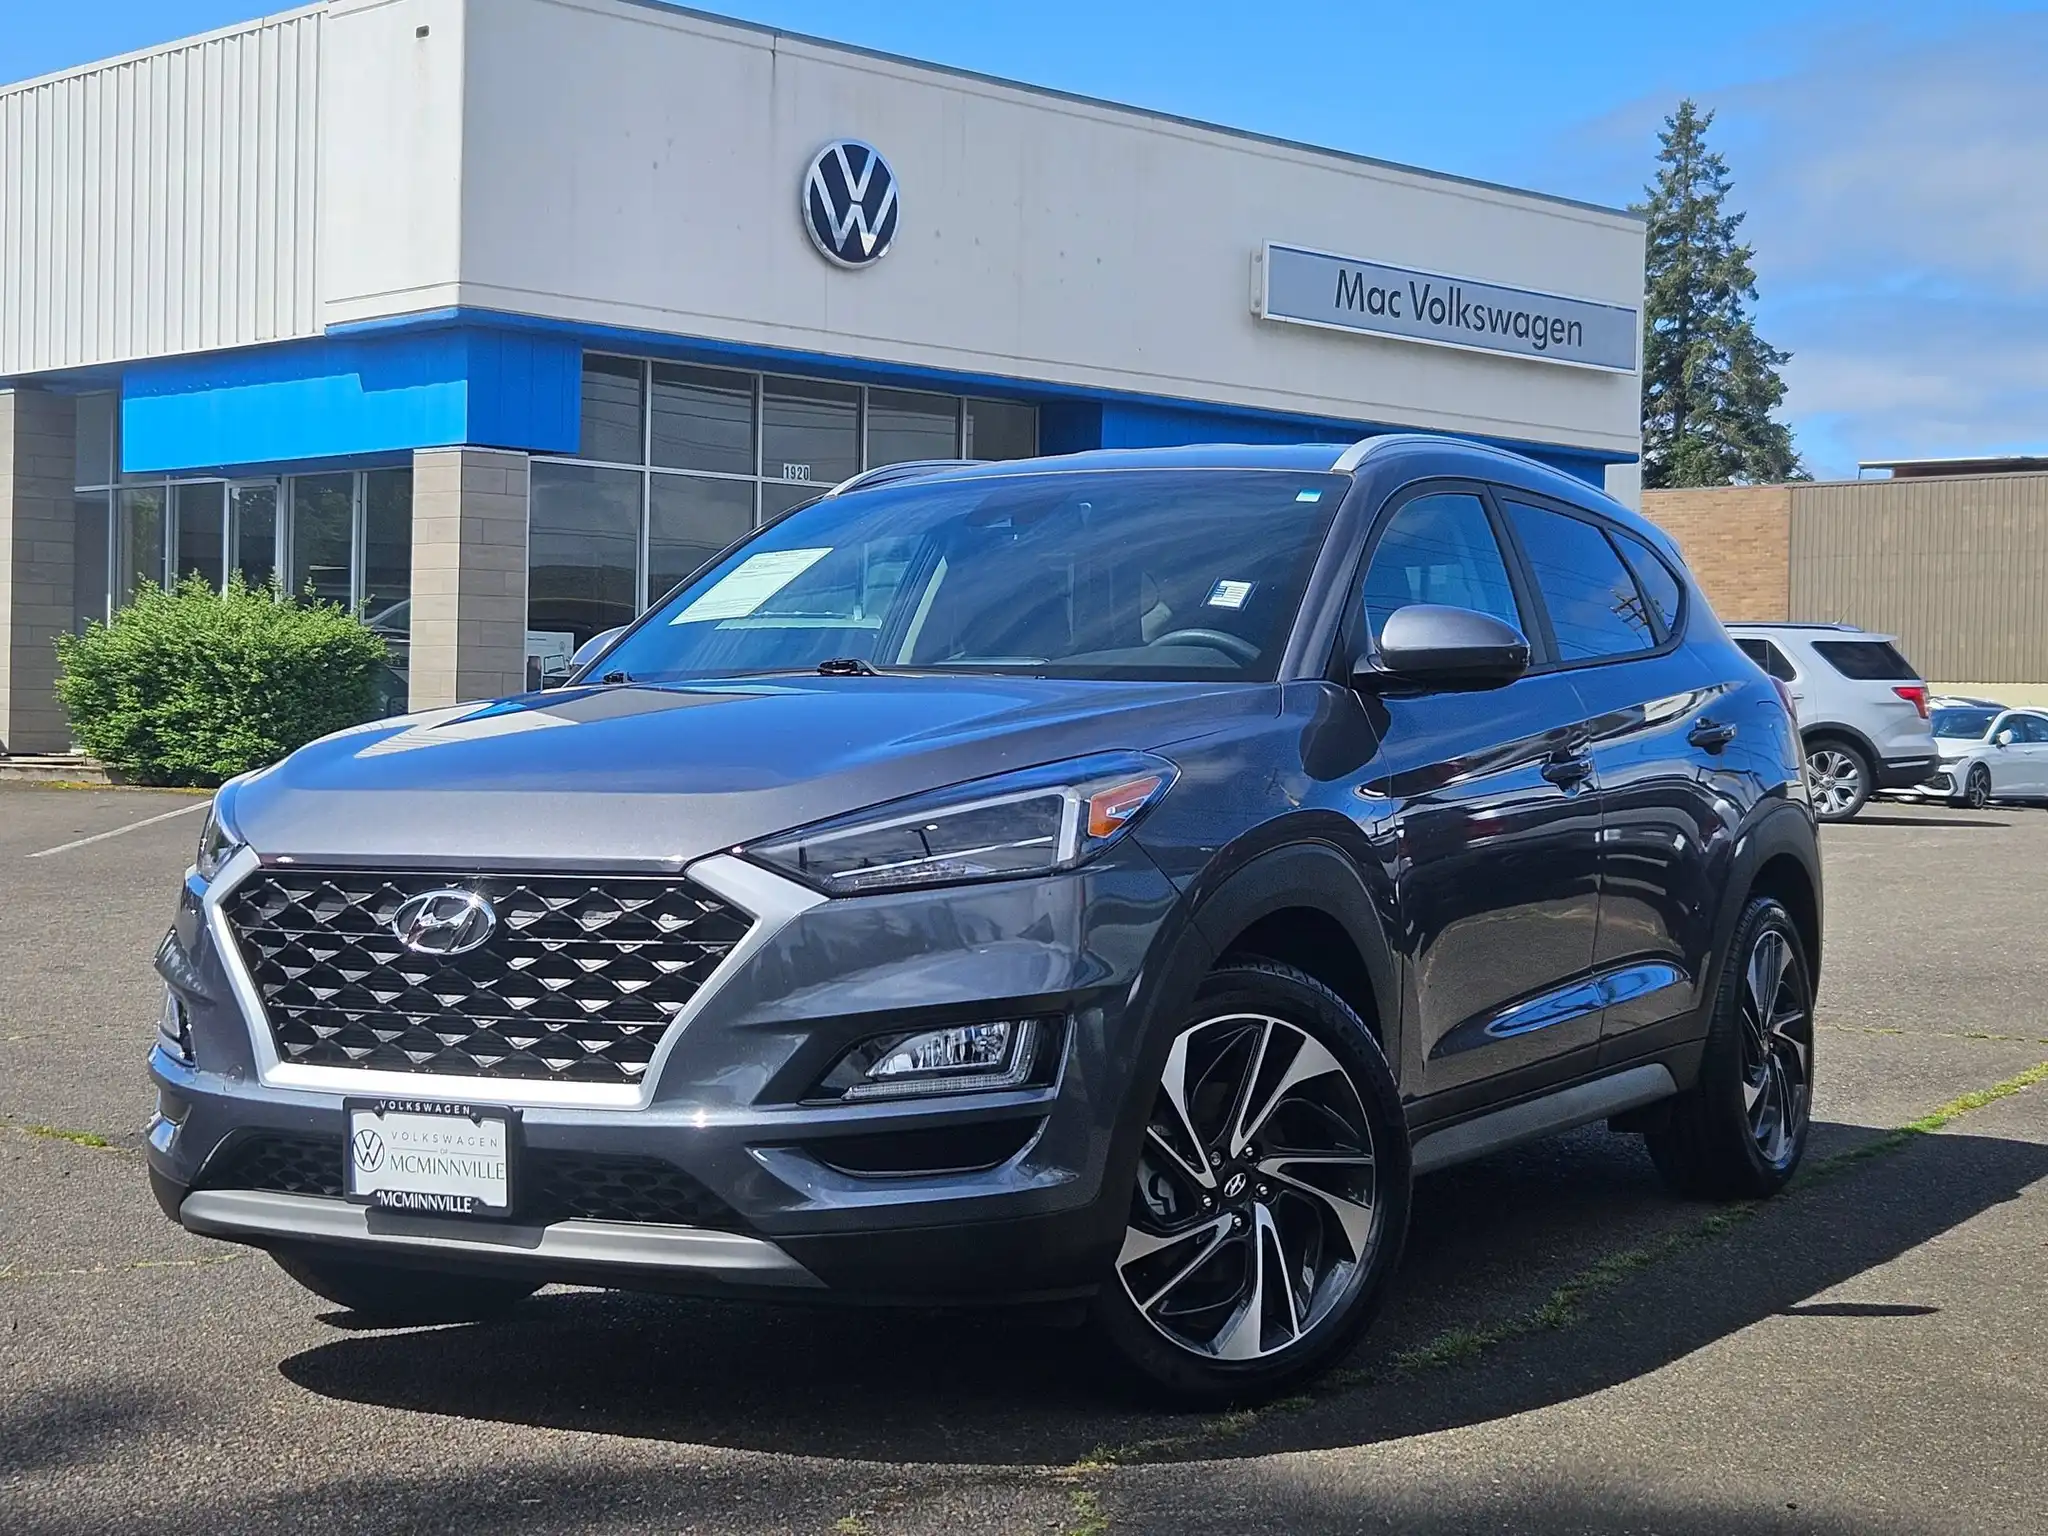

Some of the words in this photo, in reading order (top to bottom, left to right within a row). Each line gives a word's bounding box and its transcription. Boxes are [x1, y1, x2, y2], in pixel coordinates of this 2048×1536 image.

[1334, 268, 1402, 319] Mac
[1408, 280, 1583, 351] Volkswagen
[784, 464, 809, 481] 1920
[379, 1099, 472, 1115] VOLKSWAGEN
[390, 1131, 499, 1148] VOLKSWAGEN
[389, 1154, 505, 1180] MCMINNVILLE
[379, 1191, 473, 1214] MCMINNVILLE
